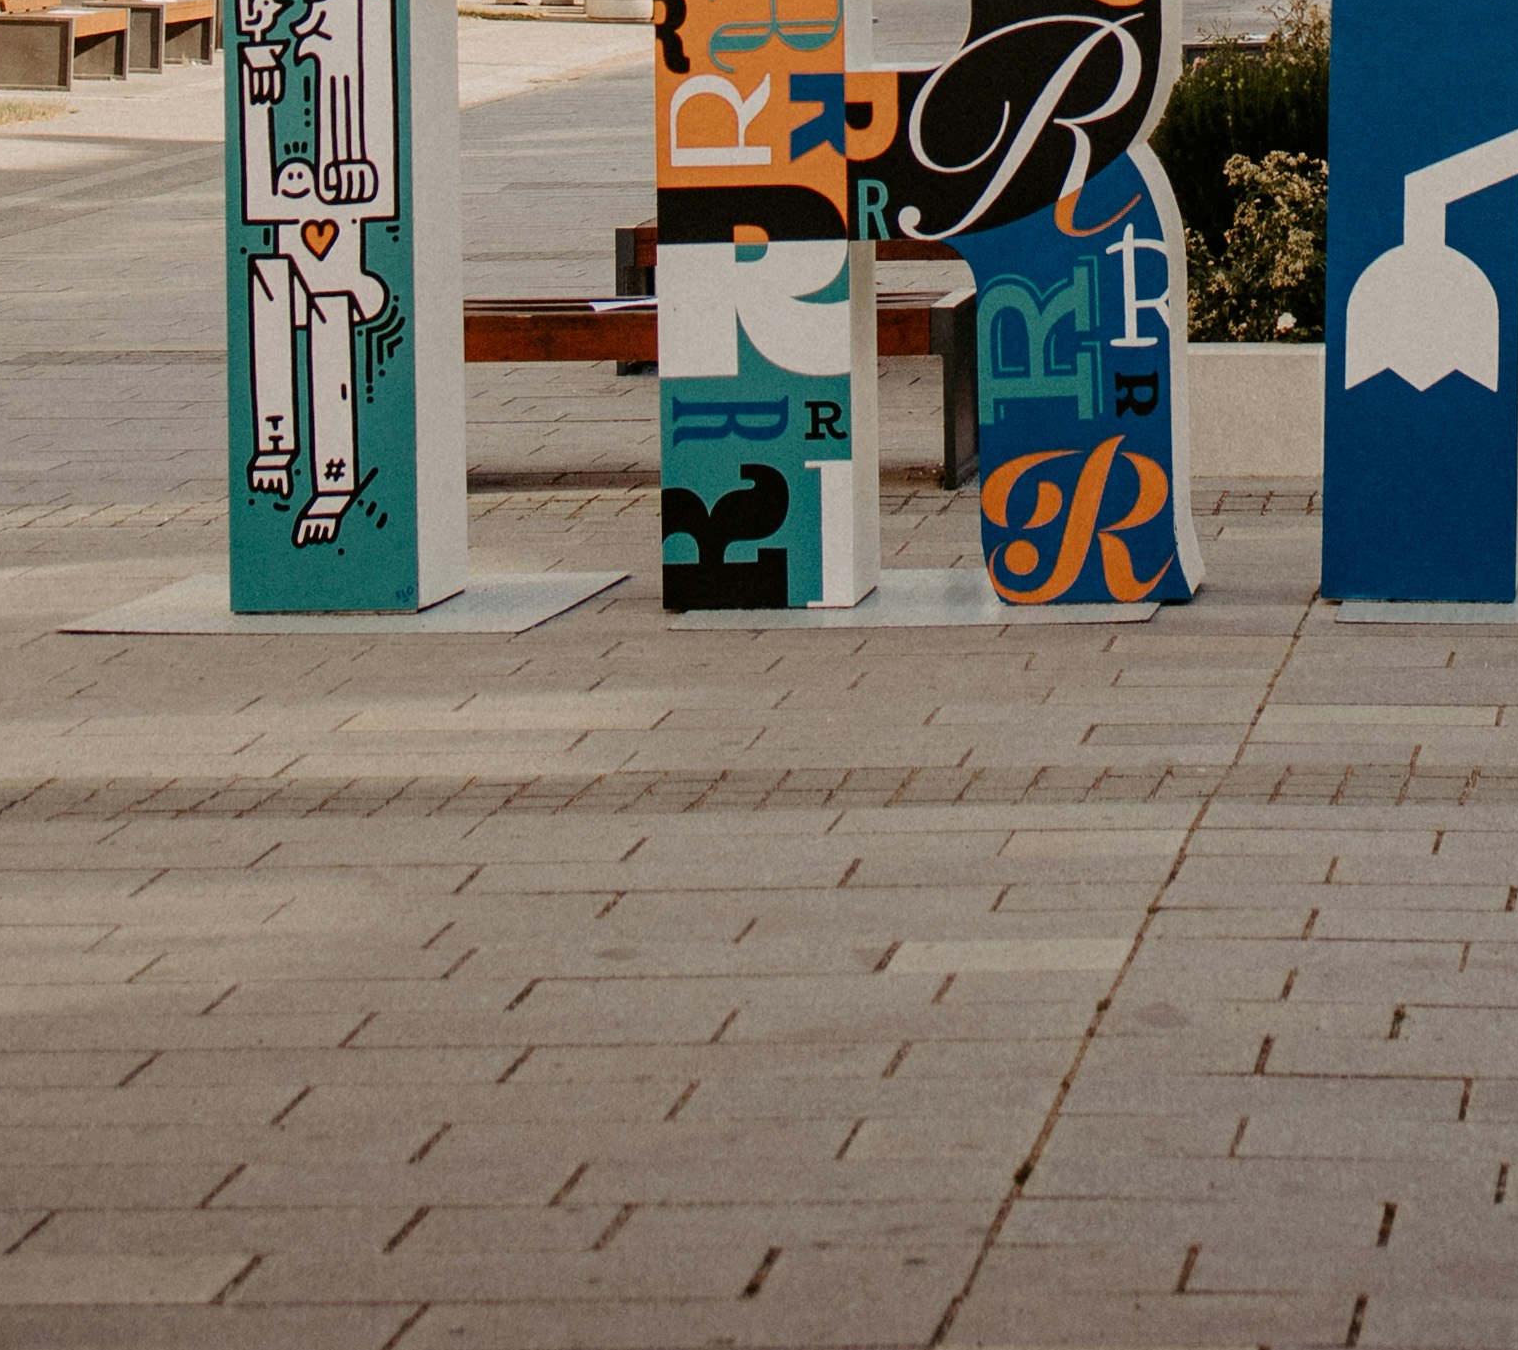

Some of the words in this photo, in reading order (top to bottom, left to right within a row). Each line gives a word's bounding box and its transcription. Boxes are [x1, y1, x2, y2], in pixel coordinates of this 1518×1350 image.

[670, 73, 772, 168] R
[857, 179, 891, 241] R
[656, 184, 851, 378] R
[804, 401, 848, 440] R
[1115, 371, 1159, 419] R
[981, 434, 1176, 604] R
